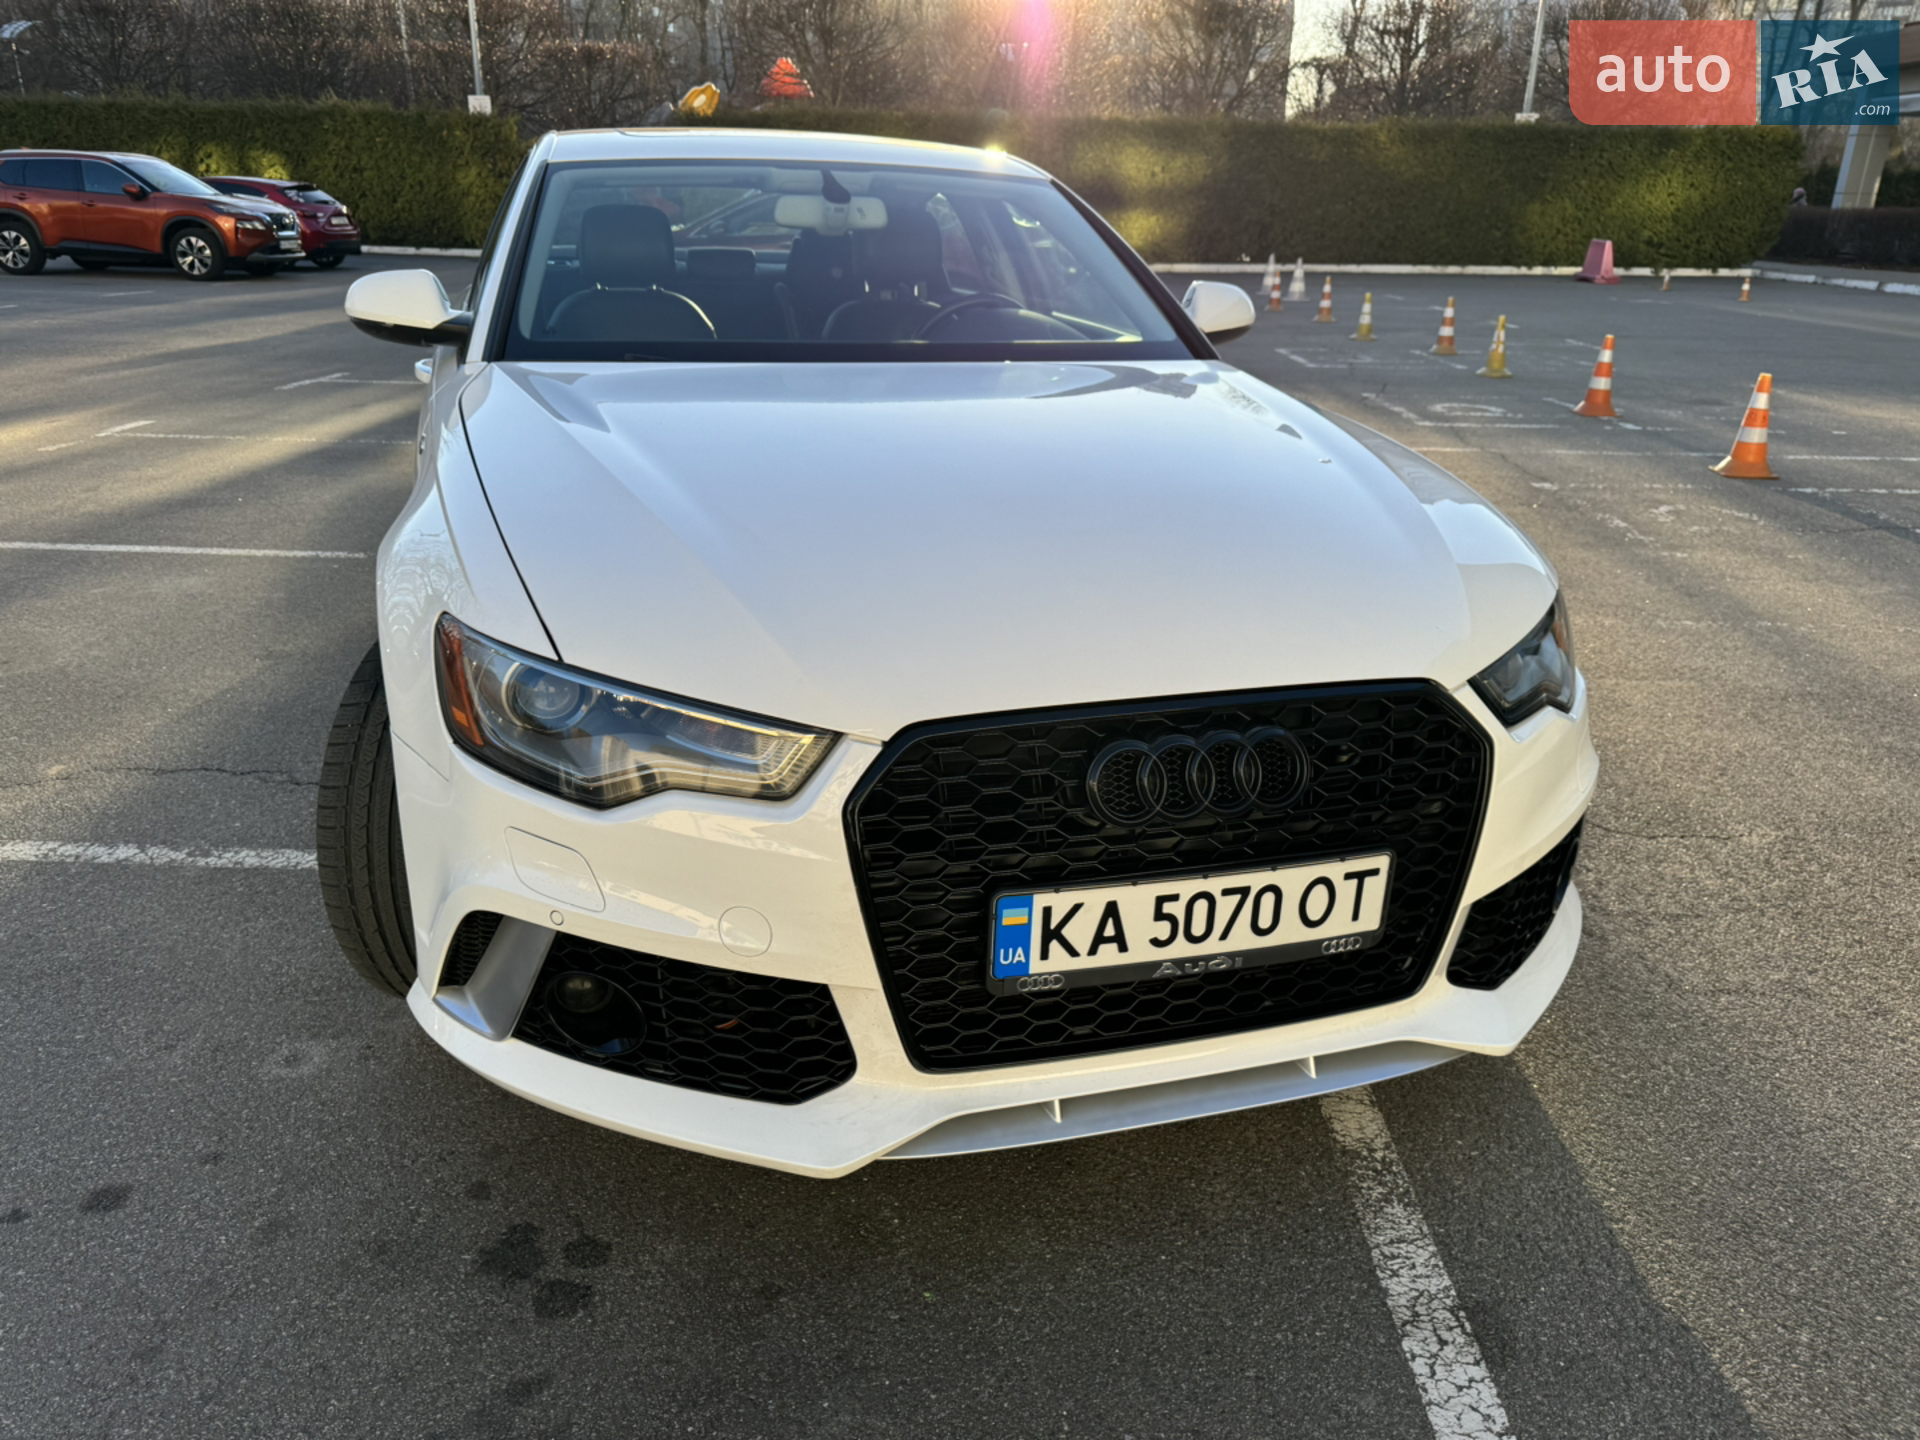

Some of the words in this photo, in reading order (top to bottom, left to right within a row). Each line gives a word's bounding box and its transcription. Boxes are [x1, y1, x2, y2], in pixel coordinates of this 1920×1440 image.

[1039, 900, 1129, 961] KA
[1148, 883, 1284, 949] 5070
[1299, 867, 1381, 929] OT
[999, 947, 1027, 966] UA
